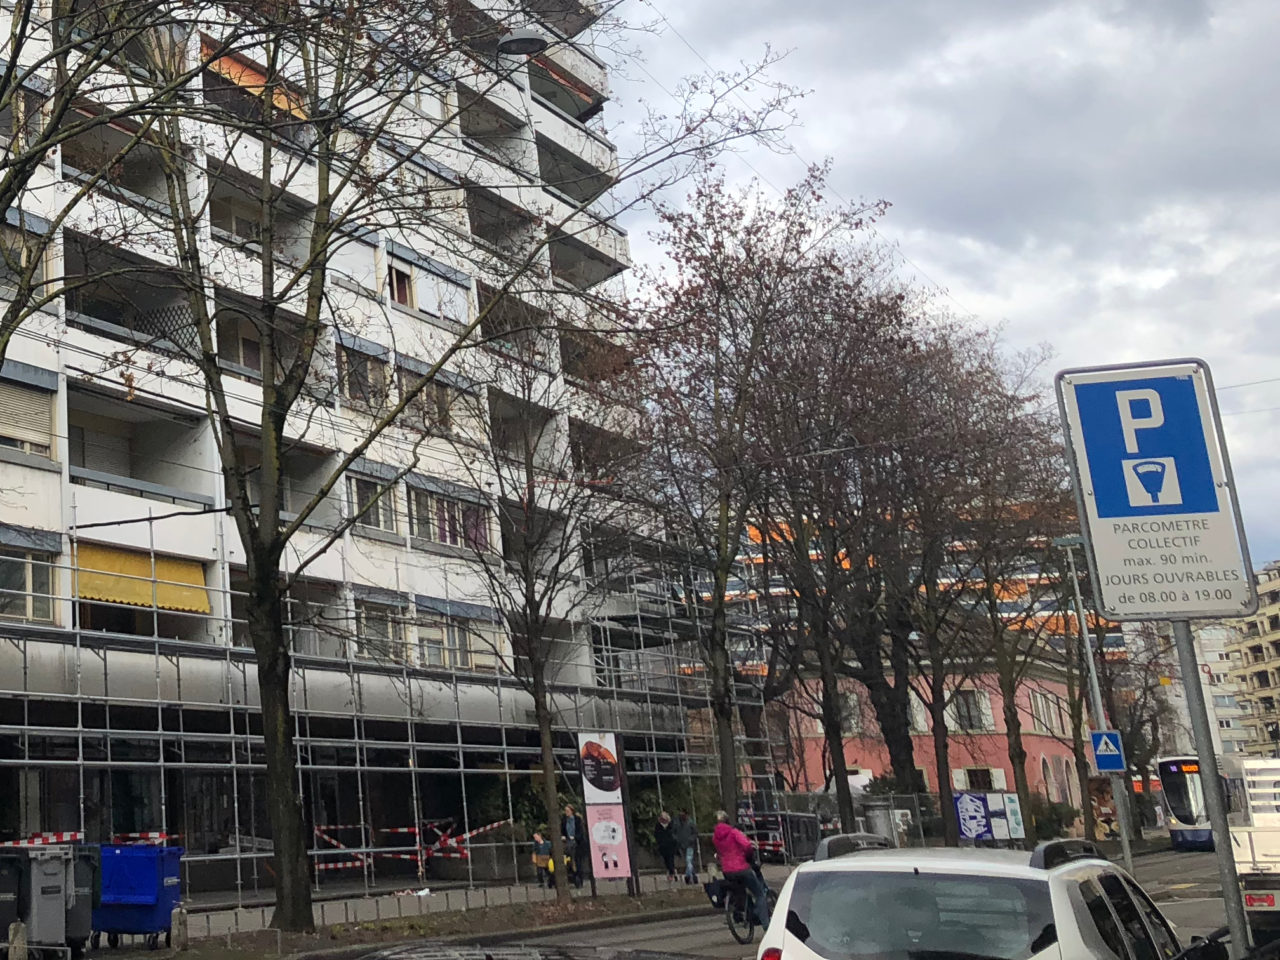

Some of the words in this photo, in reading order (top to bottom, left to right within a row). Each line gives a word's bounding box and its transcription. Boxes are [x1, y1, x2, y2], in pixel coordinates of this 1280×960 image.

[1115, 388, 1165, 454] P
[1112, 519, 1210, 534] PARCOMETRE
[1127, 536, 1201, 550] COLLECTIF
[1123, 556, 1156, 567] max.
[1160, 553, 1177, 565] 90
[1181, 552, 1213, 564] min.
[1105, 573, 1149, 586] JOURS
[1153, 569, 1240, 584] OUVRABLES
[1118, 592, 1136, 604] de
[1139, 591, 1177, 603] 08.00
[1181, 590, 1190, 601] à
[1194, 588, 1232, 601] 19.00
